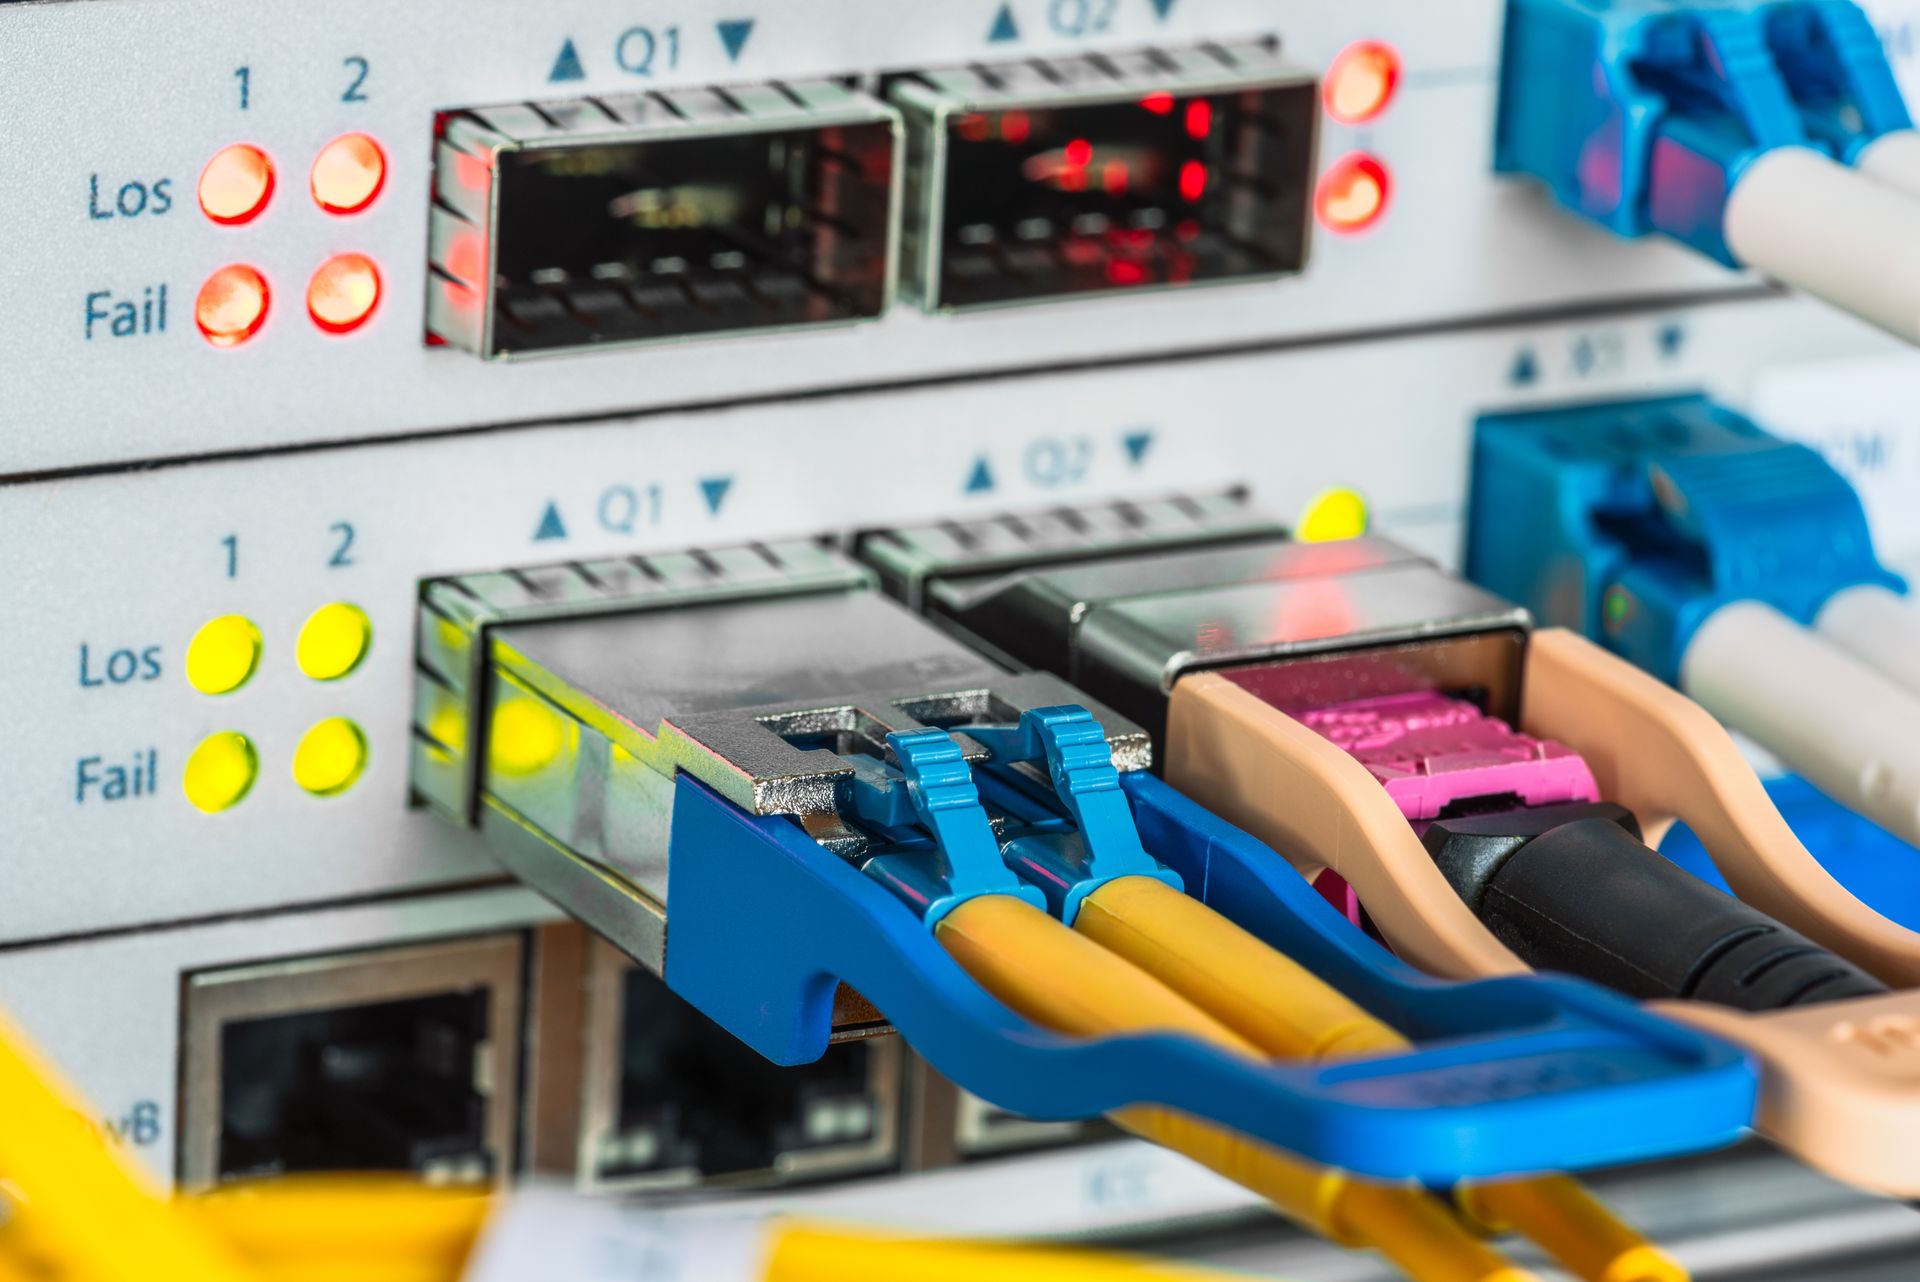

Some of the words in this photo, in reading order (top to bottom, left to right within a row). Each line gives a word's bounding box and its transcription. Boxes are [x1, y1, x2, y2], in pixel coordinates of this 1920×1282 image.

[615, 26, 680, 76] Q1
[234, 66, 251, 110] 1
[340, 55, 370, 104] 2
[87, 173, 173, 221] Los
[84, 283, 168, 341] Fail
[596, 482, 664, 535] Q1
[221, 533, 239, 580] 1
[327, 521, 356, 570] 2
[78, 642, 163, 689] Los
[75, 749, 158, 805] Fail
